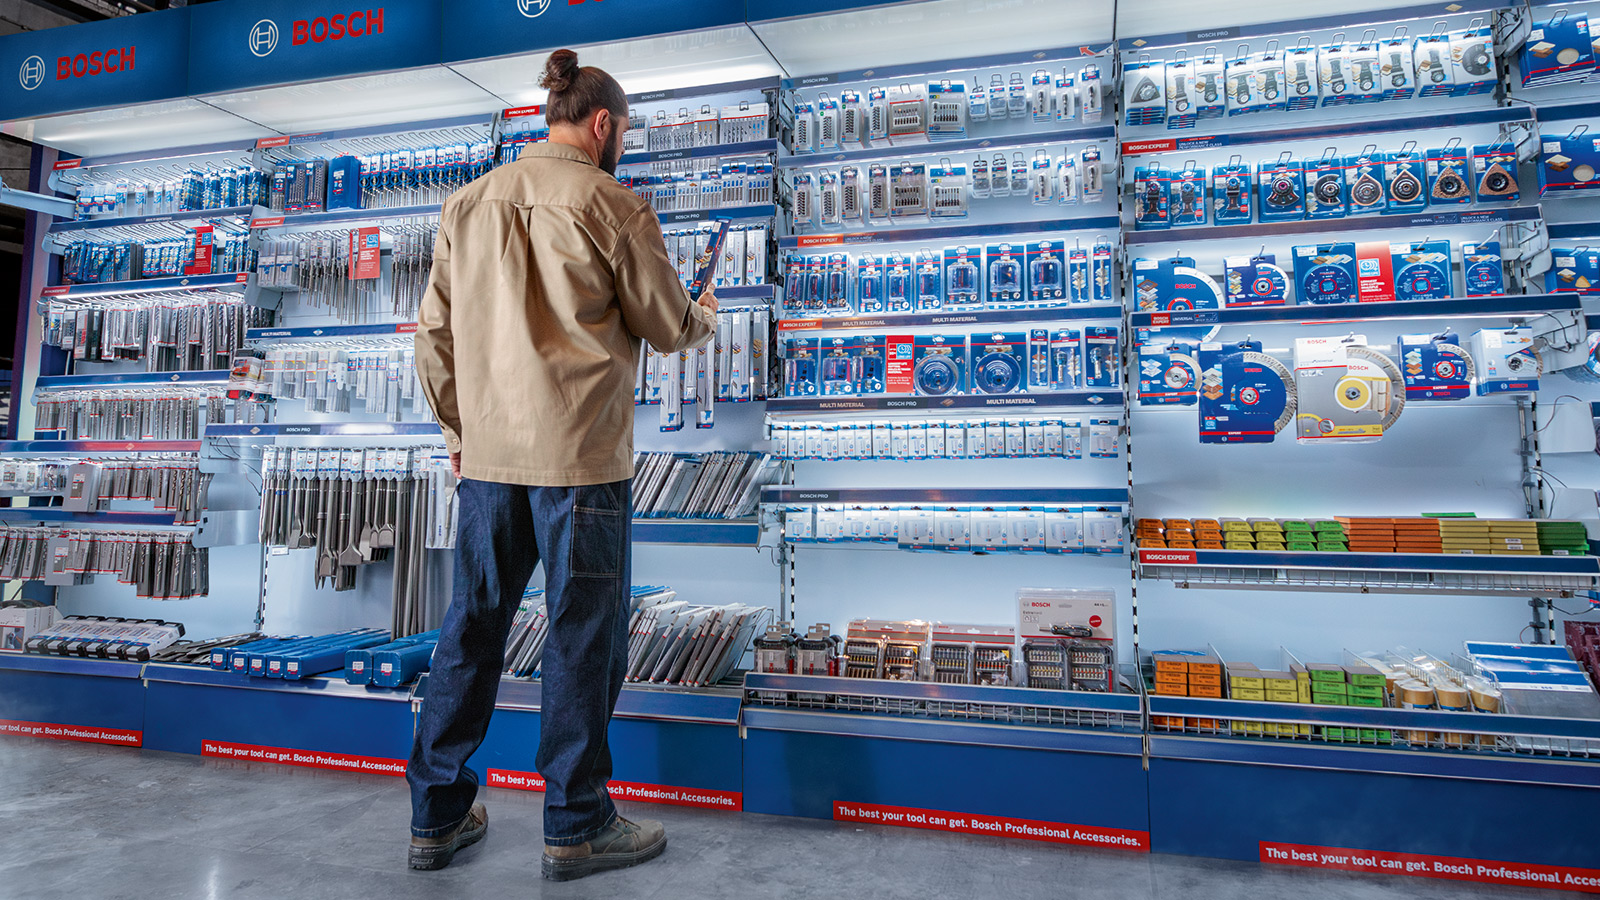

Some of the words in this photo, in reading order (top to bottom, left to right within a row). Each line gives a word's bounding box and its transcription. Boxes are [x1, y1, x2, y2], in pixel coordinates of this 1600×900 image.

[292, 8, 384, 46] BOSCH
[56, 46, 136, 81] BOSCH
[32, 727, 43, 735] get.
[45, 727, 63, 735] Bosch
[63, 729, 100, 739] Professional
[100, 732, 138, 742] Accessories.
[205, 744, 217, 753] The
[218, 745, 232, 754] best
[234, 748, 249, 757] your
[250, 749, 264, 758] tool
[279, 753, 292, 762] get.
[294, 753, 315, 763] Bosch
[316, 756, 360, 768] Professional
[361, 761, 406, 772] Accessories.
[491, 773, 505, 782] The
[507, 774, 524, 784] best
[526, 777, 545, 787] your
[626, 786, 679, 800] Professional
[680, 792, 735, 806] Accessories.
[838, 806, 856, 816] The
[859, 808, 879, 819] best
[882, 811, 904, 821] your
[906, 812, 926, 824] tool
[929, 816, 946, 826] can
[949, 818, 968, 828] get.
[971, 820, 1002, 832] Bosch
[1005, 823, 1070, 839] Professional
[1073, 830, 1141, 846] Accessories.
[1266, 848, 1288, 859] The
[1291, 849, 1318, 862] best
[1321, 854, 1348, 865] your
[1351, 855, 1377, 867] tool
[1380, 860, 1402, 869] can
[1406, 861, 1430, 872] get.
[1434, 862, 1473, 875] Bosch
[1477, 865, 1561, 883] Professional
